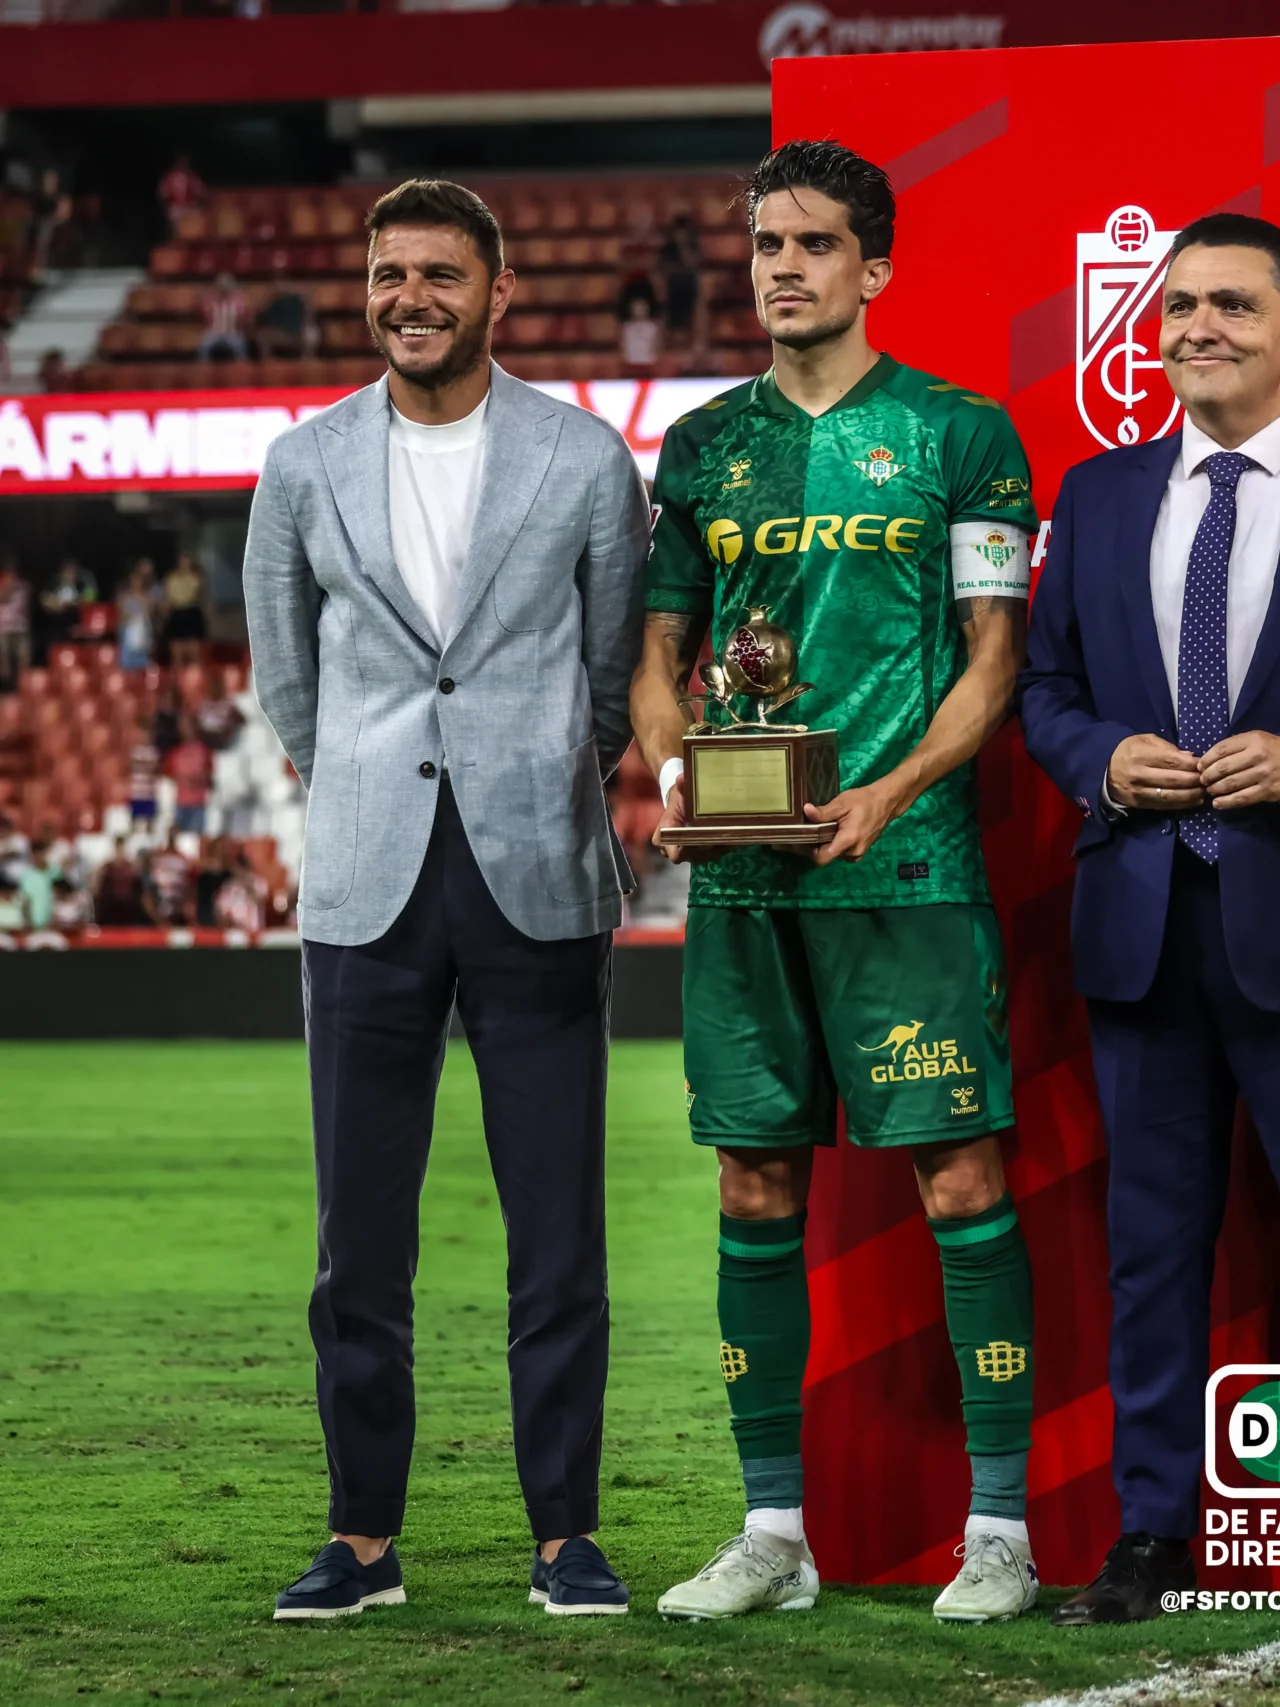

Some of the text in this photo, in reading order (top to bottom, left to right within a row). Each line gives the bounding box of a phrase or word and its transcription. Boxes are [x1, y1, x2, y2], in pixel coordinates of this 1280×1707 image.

[754, 514, 926, 555] GREE
[957, 581, 977, 590] REAL
[978, 579, 1003, 588] BETIS
[903, 1039, 958, 1062] AUS
[871, 1056, 977, 1084] GLOBAL
[951, 1103, 979, 1115] hummel
